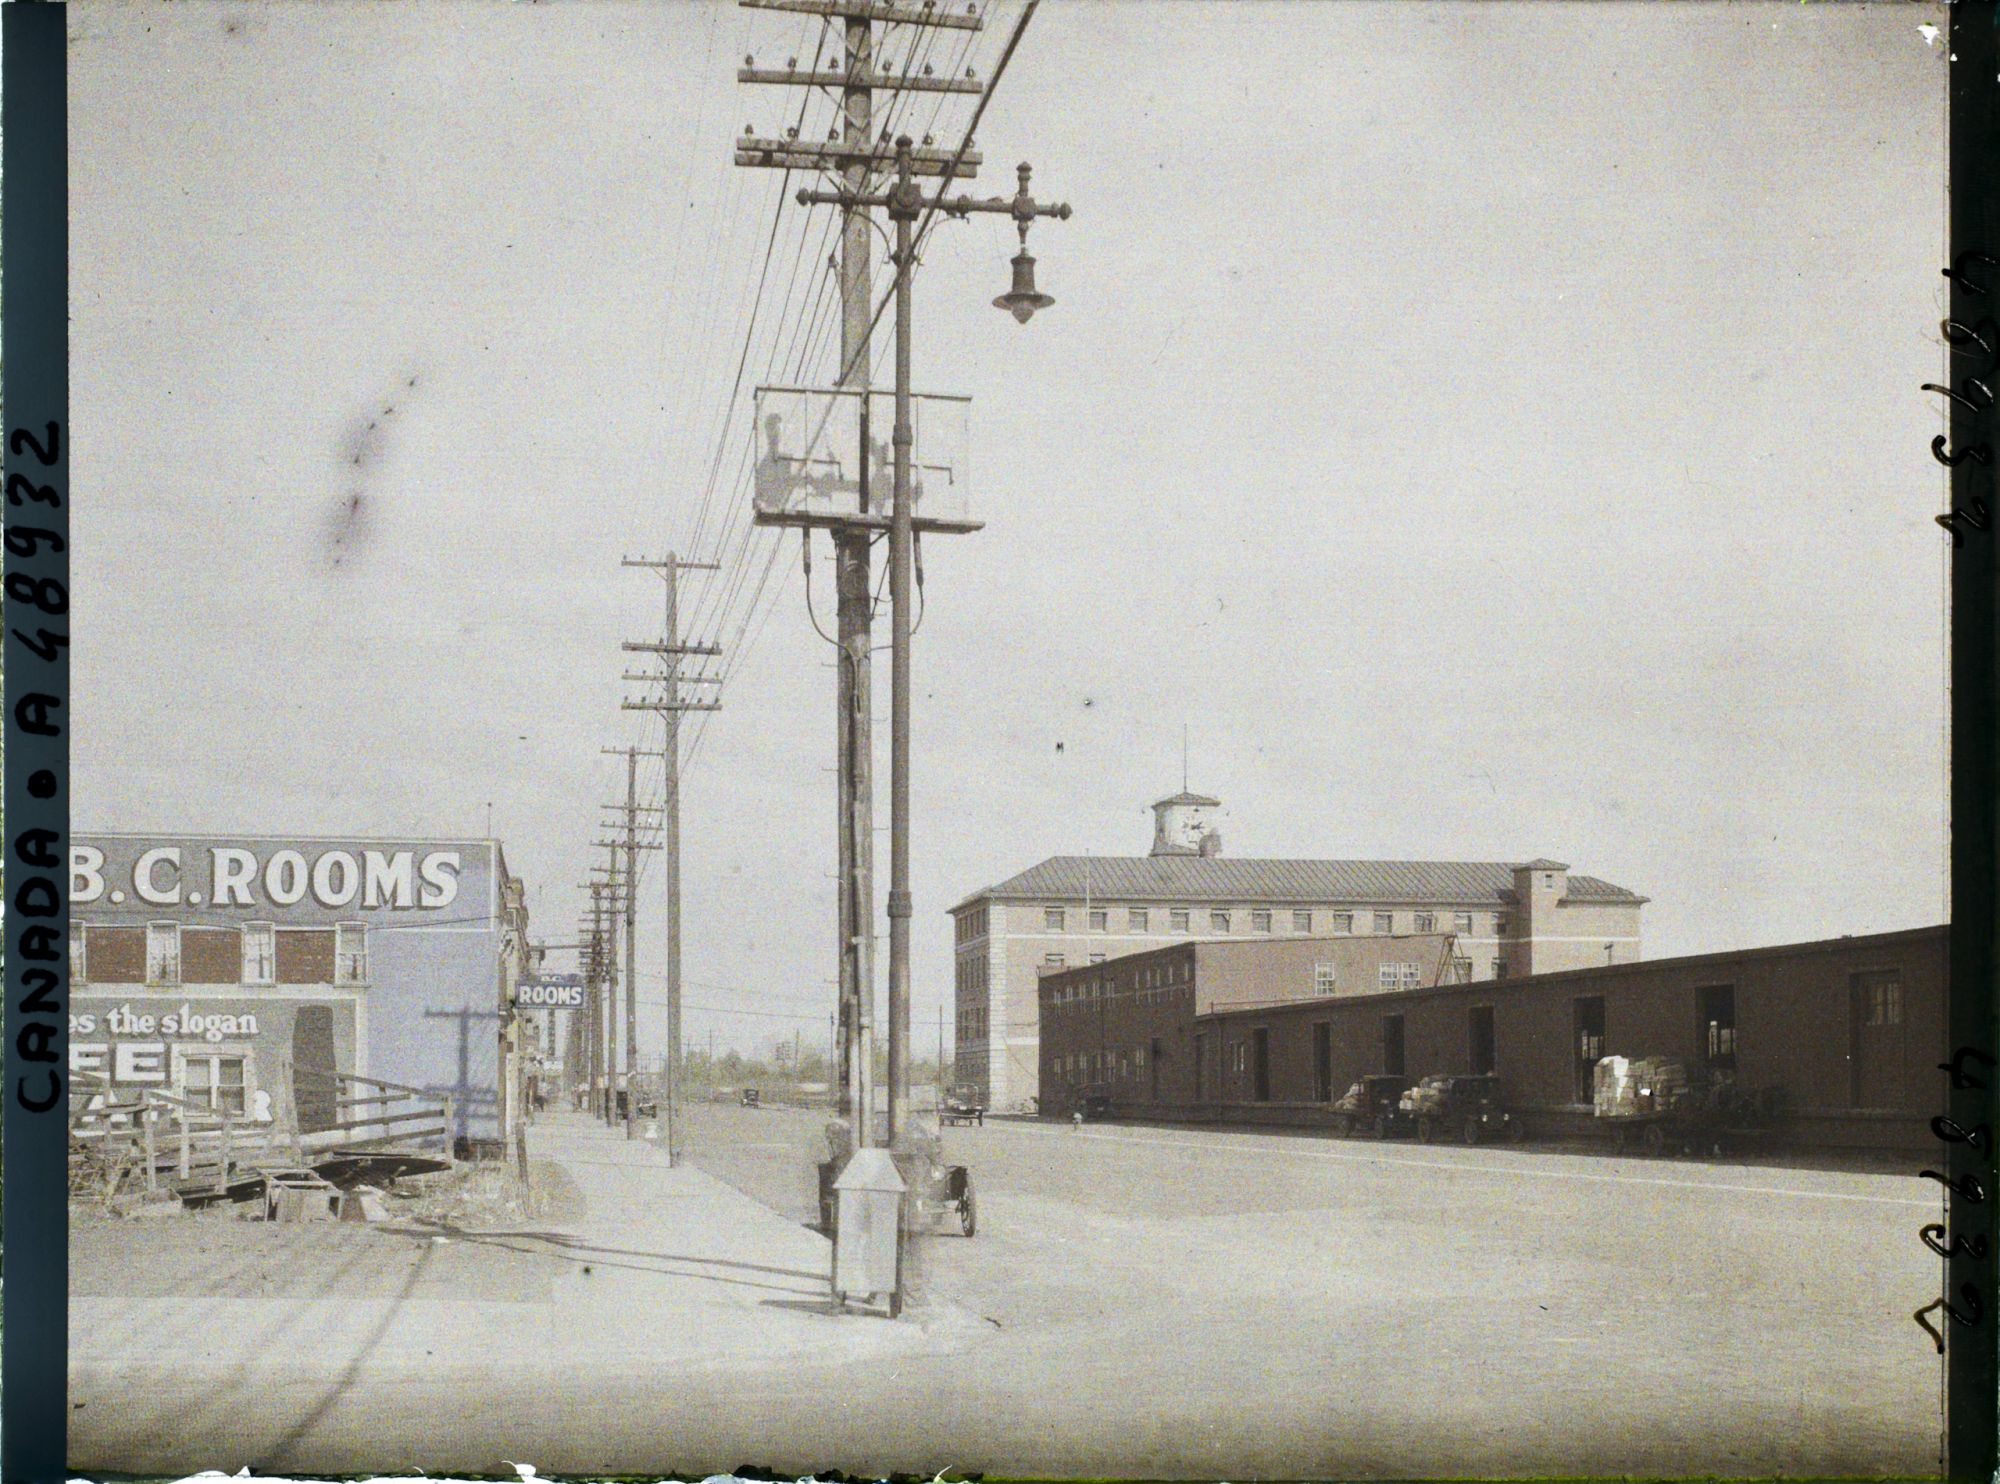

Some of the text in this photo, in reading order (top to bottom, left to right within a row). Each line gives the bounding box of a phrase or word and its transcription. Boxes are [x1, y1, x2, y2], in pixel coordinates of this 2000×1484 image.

[4, 421, 69, 1113] CANADA A 48932
[210, 848, 460, 909] ROOMS
[106, 1003, 155, 1034] the
[161, 1003, 259, 1042] slogan
[519, 985, 582, 1005] ROOMS
[1915, 1047, 1998, 1354] 48932
